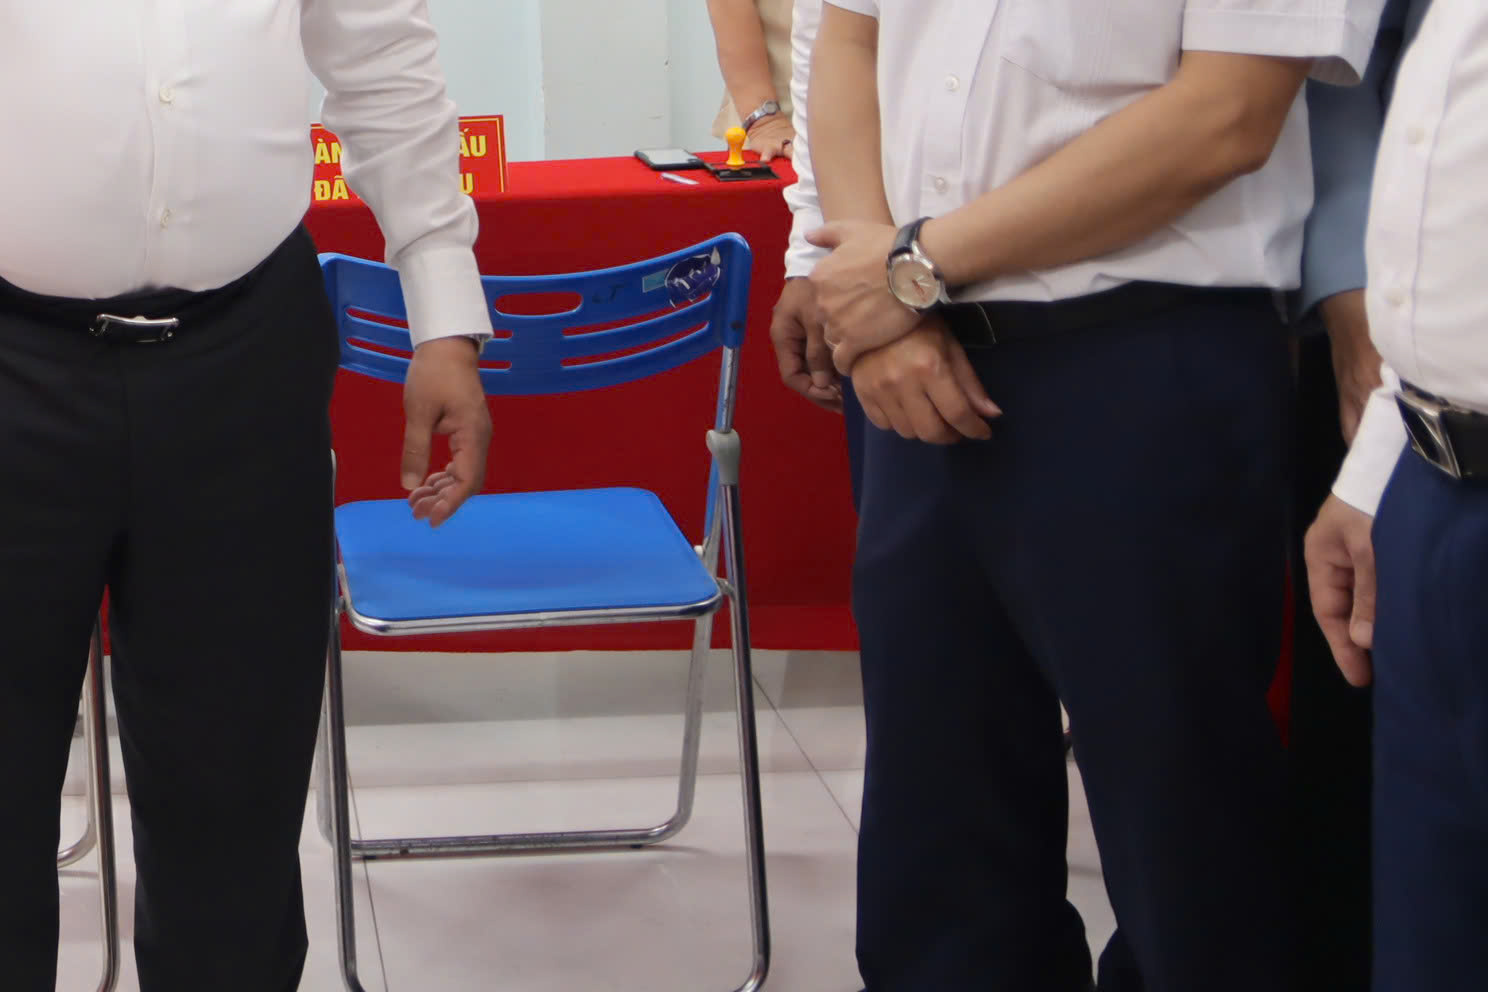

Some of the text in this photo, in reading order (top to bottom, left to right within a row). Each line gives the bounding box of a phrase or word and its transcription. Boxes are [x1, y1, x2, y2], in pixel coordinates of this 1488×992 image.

[314, 128, 487, 164] ÀN ẤU
[314, 175, 349, 200] ĐÃ
